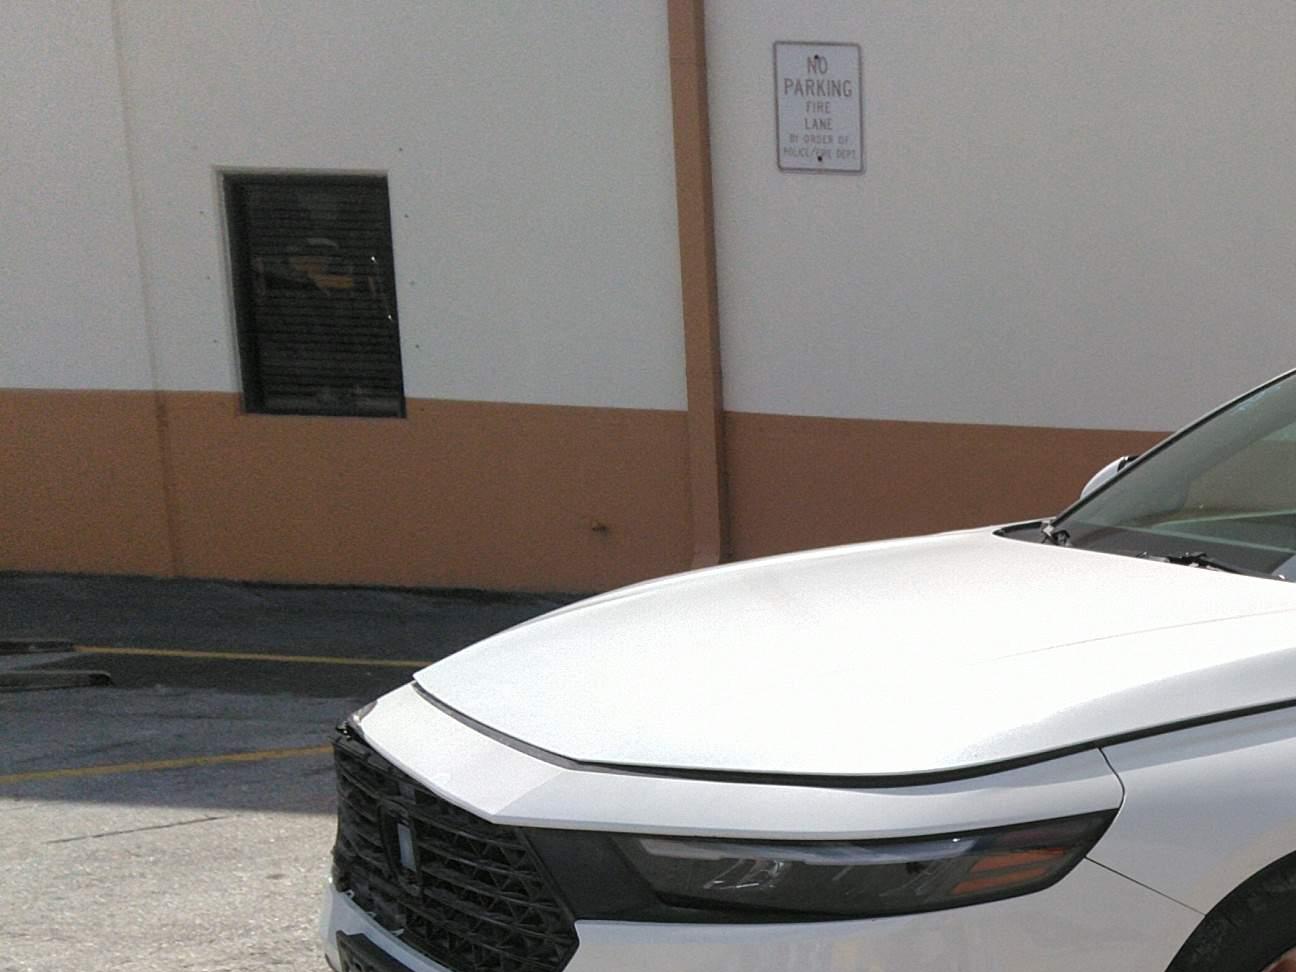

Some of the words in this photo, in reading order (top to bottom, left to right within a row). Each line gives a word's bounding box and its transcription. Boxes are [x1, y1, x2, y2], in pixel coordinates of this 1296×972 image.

[807, 56, 828, 74] NO
[784, 78, 852, 97] PARKING
[805, 101, 831, 114] FIRE
[805, 118, 832, 130] LANE
